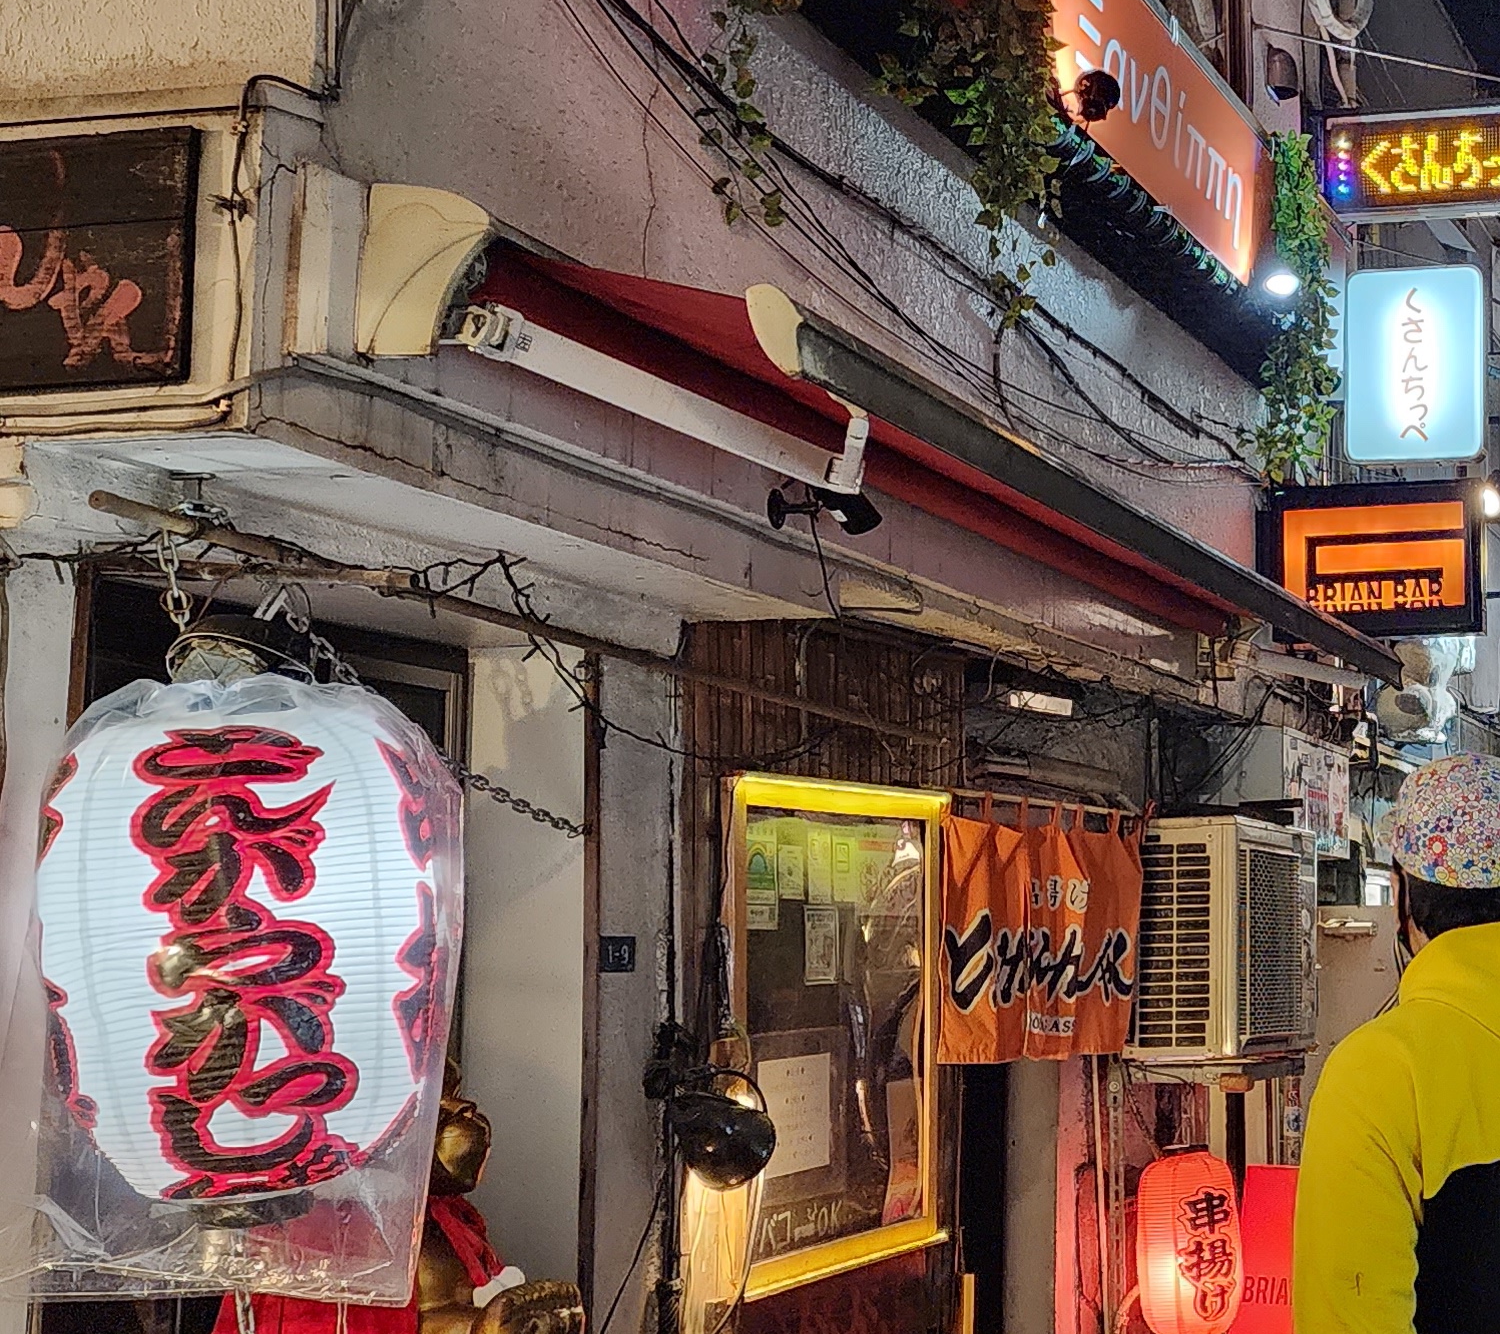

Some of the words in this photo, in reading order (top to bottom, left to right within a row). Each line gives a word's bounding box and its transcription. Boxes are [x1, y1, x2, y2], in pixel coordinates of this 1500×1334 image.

[1400, 287, 1430, 442] くさんちっぺ
[1307, 580, 1382, 613] BRIAN
[1394, 577, 1443, 610] BAR
[607, 945, 629, 965] 1-9
[817, 1199, 843, 1238] OK
[1179, 1187, 1238, 1322] 串揚げ
[1242, 1275, 1294, 1306] BRIA
